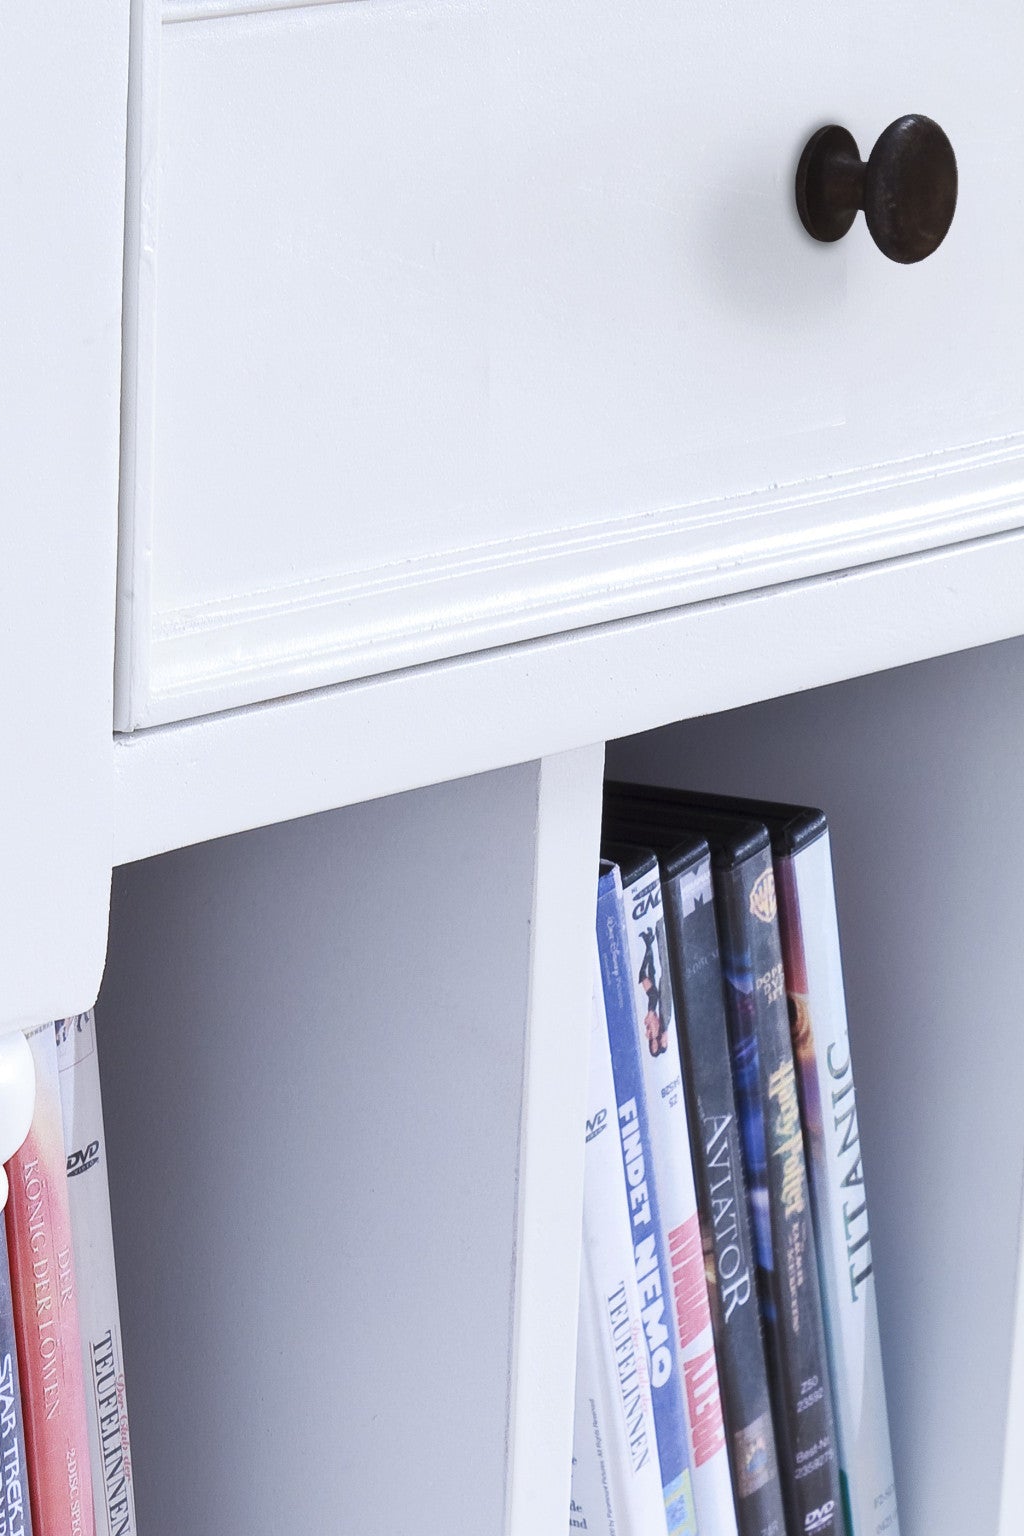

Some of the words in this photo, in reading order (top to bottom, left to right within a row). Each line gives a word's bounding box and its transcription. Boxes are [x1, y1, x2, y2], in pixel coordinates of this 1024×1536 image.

[23, 1156, 48, 1254] KÖNIG
[67, 1140, 99, 1170] DVD
[618, 1097, 652, 1227] FINDET
[772, 1130, 806, 1221] Potter
[827, 1041, 873, 1303] TITANIC
[703, 1112, 753, 1324] AVIATOR
[30, 1256, 54, 1318] DER
[56, 1247, 77, 1306] DER
[634, 1233, 672, 1388] NEMO
[668, 1210, 713, 1349] WOMAN
[37, 1317, 61, 1422] LÖWEN
[115, 1374, 125, 1410] Der
[608, 1280, 650, 1473] TEUFELINNEN
[683, 1346, 727, 1468] PRETTY
[3, 1437, 24, 1532] TREK
[805, 1499, 835, 1526] DVD
